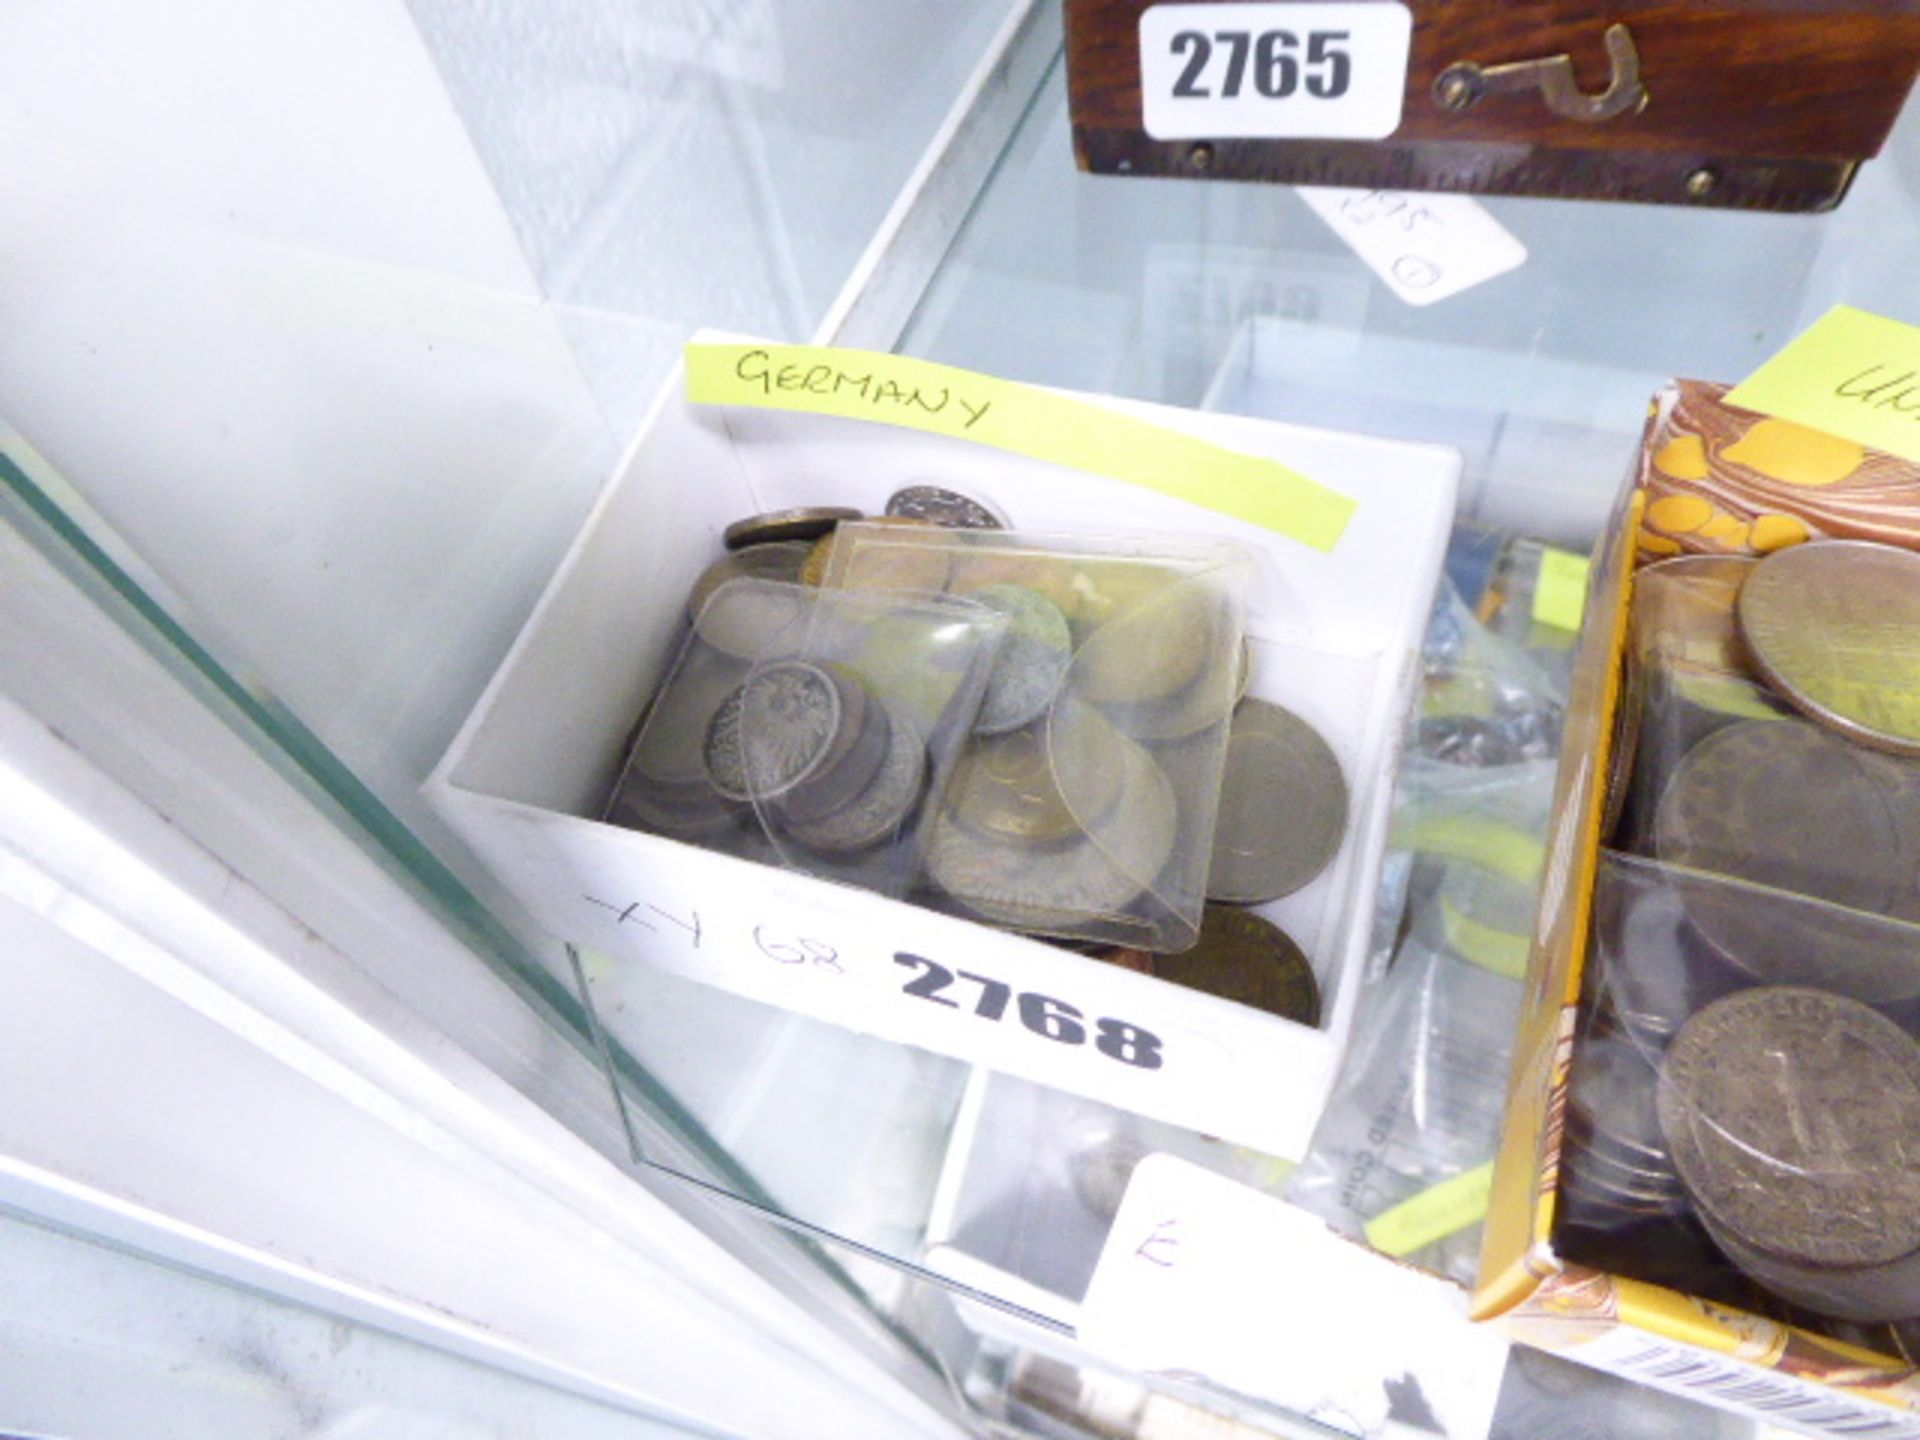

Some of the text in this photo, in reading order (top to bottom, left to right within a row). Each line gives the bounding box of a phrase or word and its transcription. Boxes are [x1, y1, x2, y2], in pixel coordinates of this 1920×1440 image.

[1170, 30, 1351, 98] 2765
[735, 349, 992, 428] GERMANY
[893, 951, 1164, 1069] 2768
